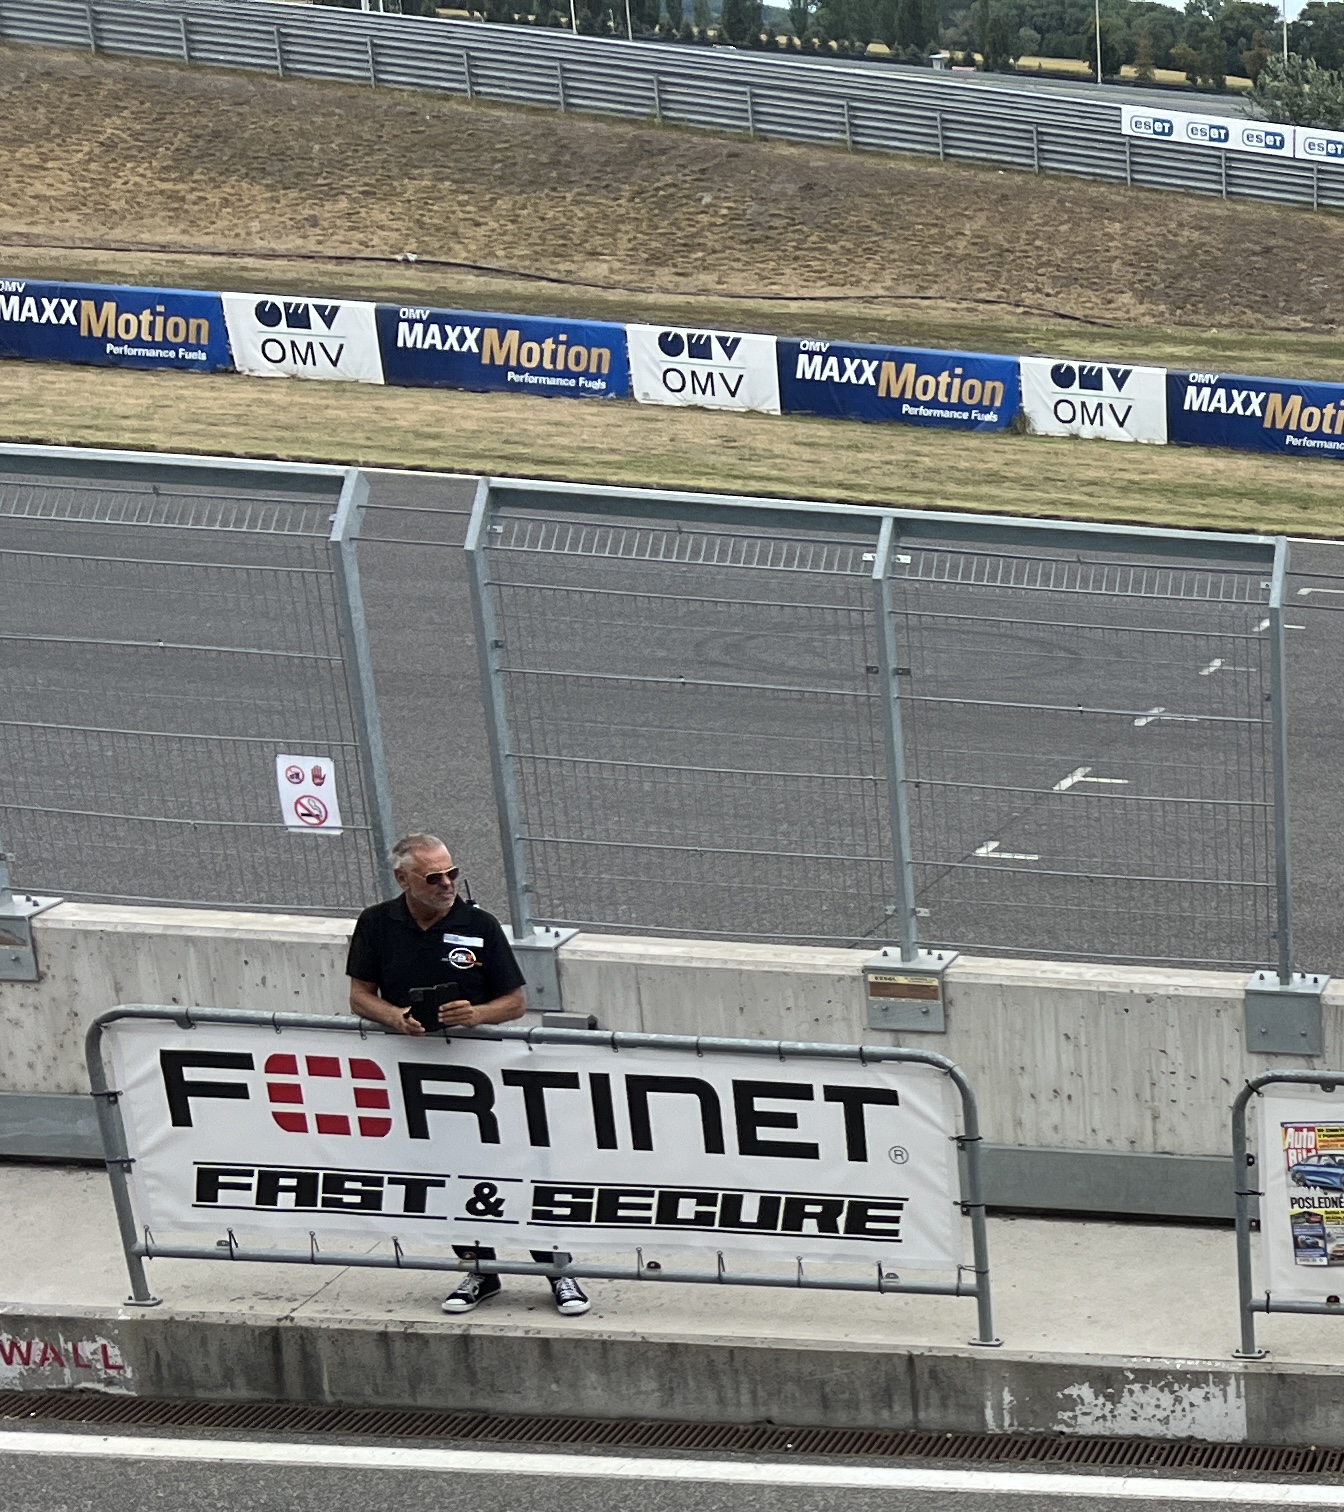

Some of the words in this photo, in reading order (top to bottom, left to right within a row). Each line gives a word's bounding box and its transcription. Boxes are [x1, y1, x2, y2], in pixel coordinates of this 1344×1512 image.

[106, 342, 176, 358] Performance
[261, 338, 344, 367] OMV
[507, 371, 576, 387] Performance
[662, 368, 743, 398] OMV
[901, 404, 969, 419] Performance
[1053, 399, 1132, 428] OMV
[158, 1048, 900, 1164] FORTINET
[1286, 1128, 1315, 1148] Auto
[196, 1166, 446, 1214] FAST
[465, 1180, 505, 1219] &
[530, 1184, 905, 1238] SECURE
[0, 1339, 124, 1370] WALL
